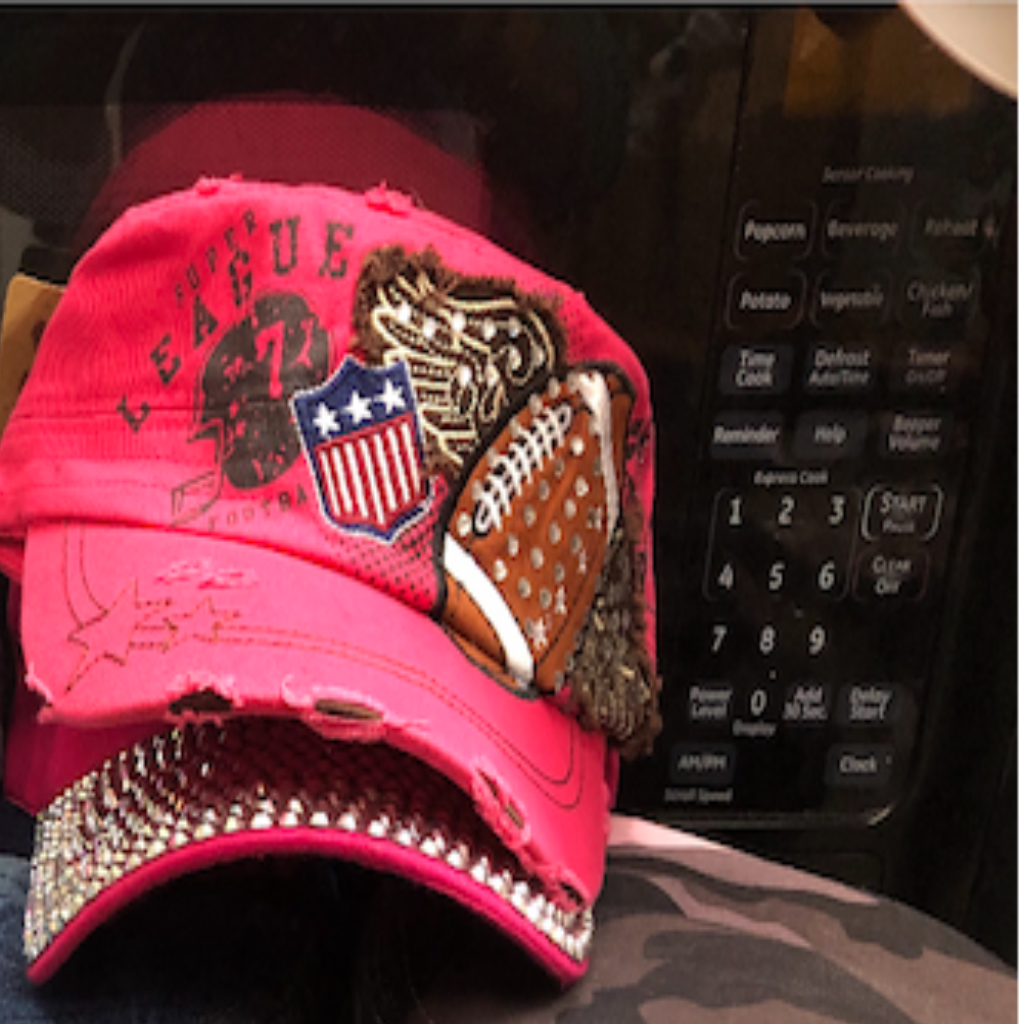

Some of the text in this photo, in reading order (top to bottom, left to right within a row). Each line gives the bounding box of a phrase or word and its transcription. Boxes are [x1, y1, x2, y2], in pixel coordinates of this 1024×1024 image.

[745, 220, 807, 243] Popcorn
[828, 219, 898, 241] Beverage
[740, 290, 792, 310] Potato
[116, 215, 354, 433] LEAGUE
[739, 350, 776, 367] Time
[814, 348, 871, 367] Defrost
[735, 370, 774, 388] Cook
[893, 415, 942, 434] Beeper
[713, 424, 780, 445] Reminder
[814, 425, 848, 446] Help
[728, 497, 846, 525] 1 2 3
[879, 491, 928, 514] START
[718, 562, 836, 591] 4 5 6
[711, 625, 826, 655] 7 8 9
[689, 686, 733, 702] Power
[750, 689, 768, 717] 0
[793, 686, 823, 702] Add
[849, 686, 893, 704] Delay
[690, 702, 728, 719] Level
[849, 703, 887, 721] Start
[678, 755, 727, 772] AM/PM
[839, 755, 878, 773] Clock
